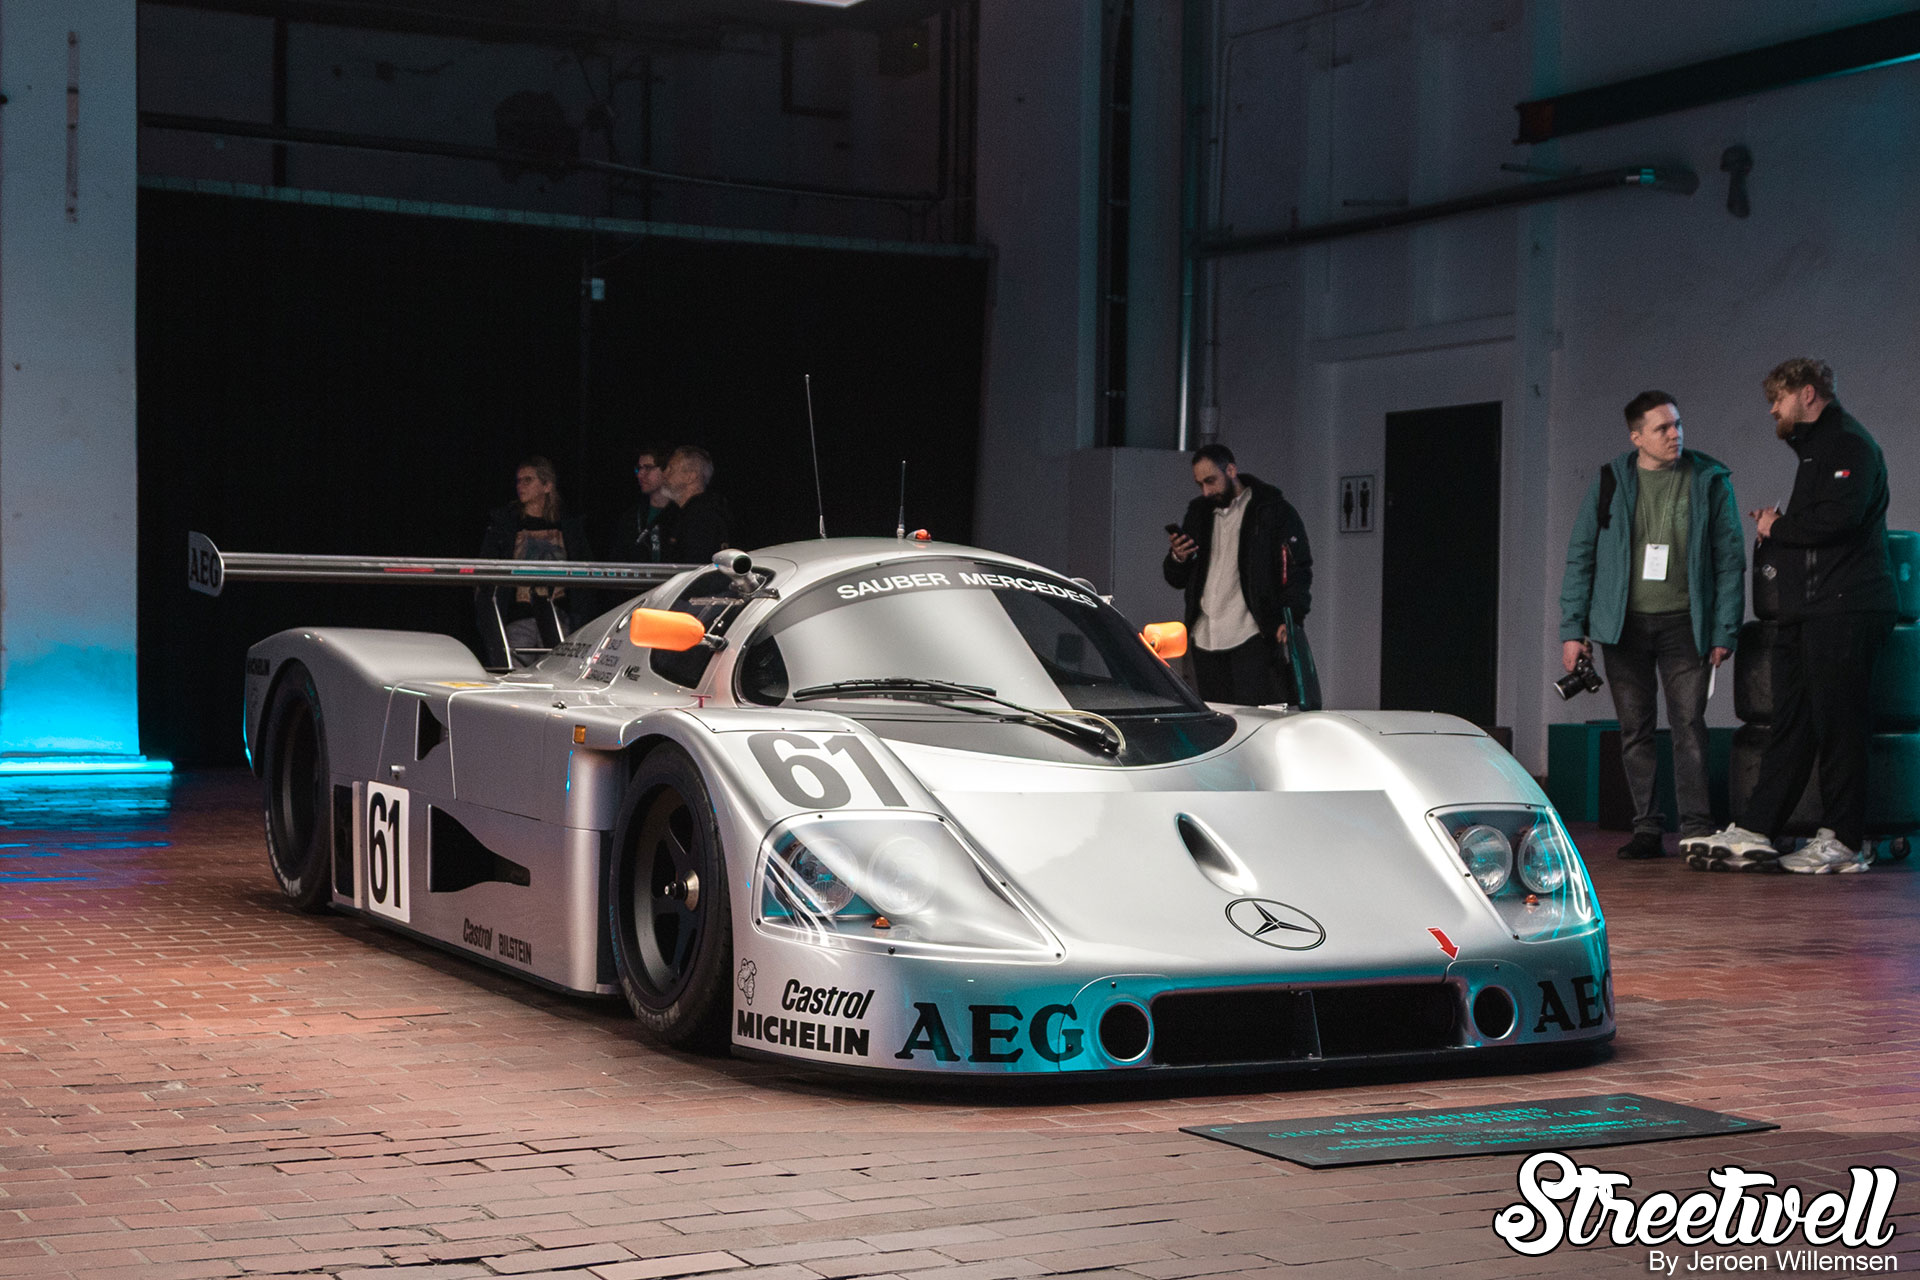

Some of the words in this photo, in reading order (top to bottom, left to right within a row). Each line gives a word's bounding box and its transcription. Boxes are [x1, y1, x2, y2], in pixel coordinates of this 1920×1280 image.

[189, 547, 219, 588] AEG
[837, 572, 950, 601] SAUBER
[959, 571, 1099, 609] MERCEDES
[747, 732, 909, 809] 61
[369, 791, 402, 909] 61
[463, 917, 493, 951] Castrol
[498, 933, 532, 965] BILSTEIN
[782, 978, 875, 1020] Castrol
[737, 1010, 870, 1057] MICHELIN
[894, 1002, 1085, 1063] AEG
